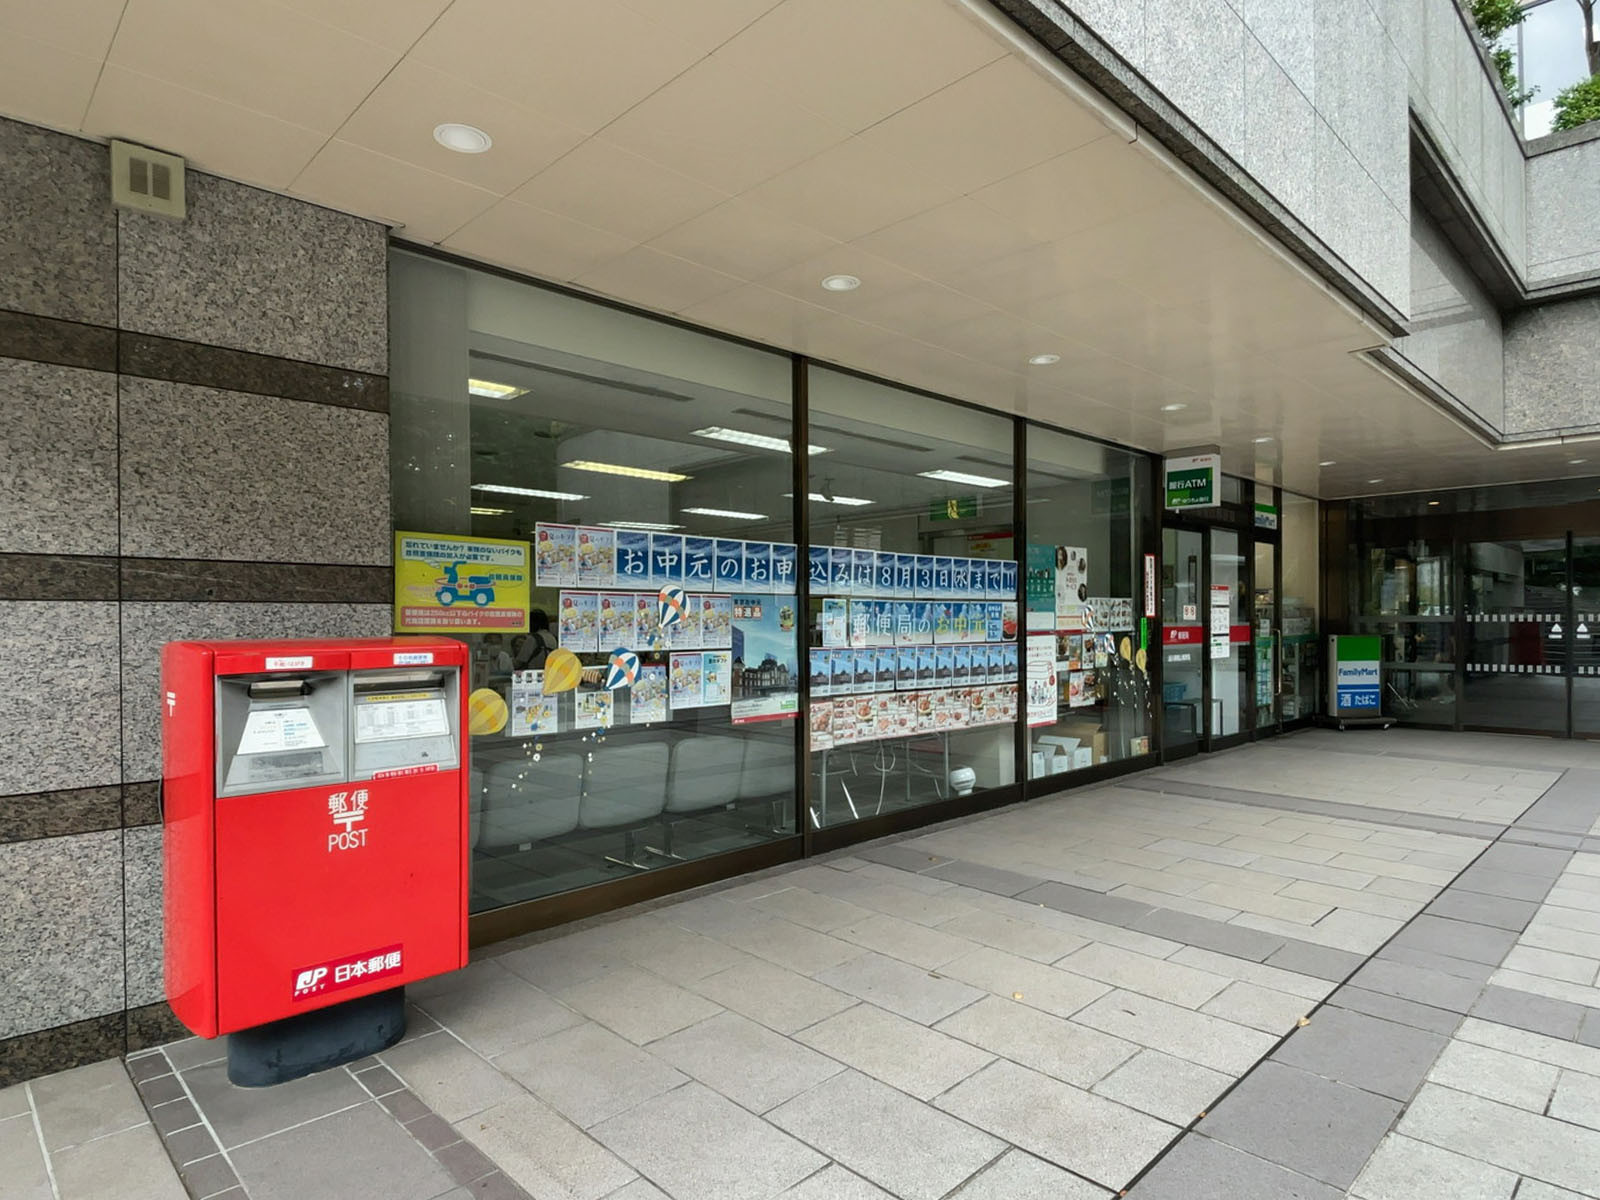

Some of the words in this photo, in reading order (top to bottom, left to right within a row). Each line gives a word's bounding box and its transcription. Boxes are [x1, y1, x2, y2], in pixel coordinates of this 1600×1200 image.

[1168, 478, 1206, 490] 銀行ATM
[734, 606, 761, 618] 特選品
[853, 613, 985, 637] 郵便局のお中元
[1339, 668, 1377, 677] FamilyMart
[1340, 694, 1352, 707] 酒
[1355, 694, 1376, 706] たばこ
[328, 789, 368, 815] 郵便
[328, 828, 368, 854] POST
[335, 950, 401, 984] 日本郵便
[294, 984, 326, 997] POST
